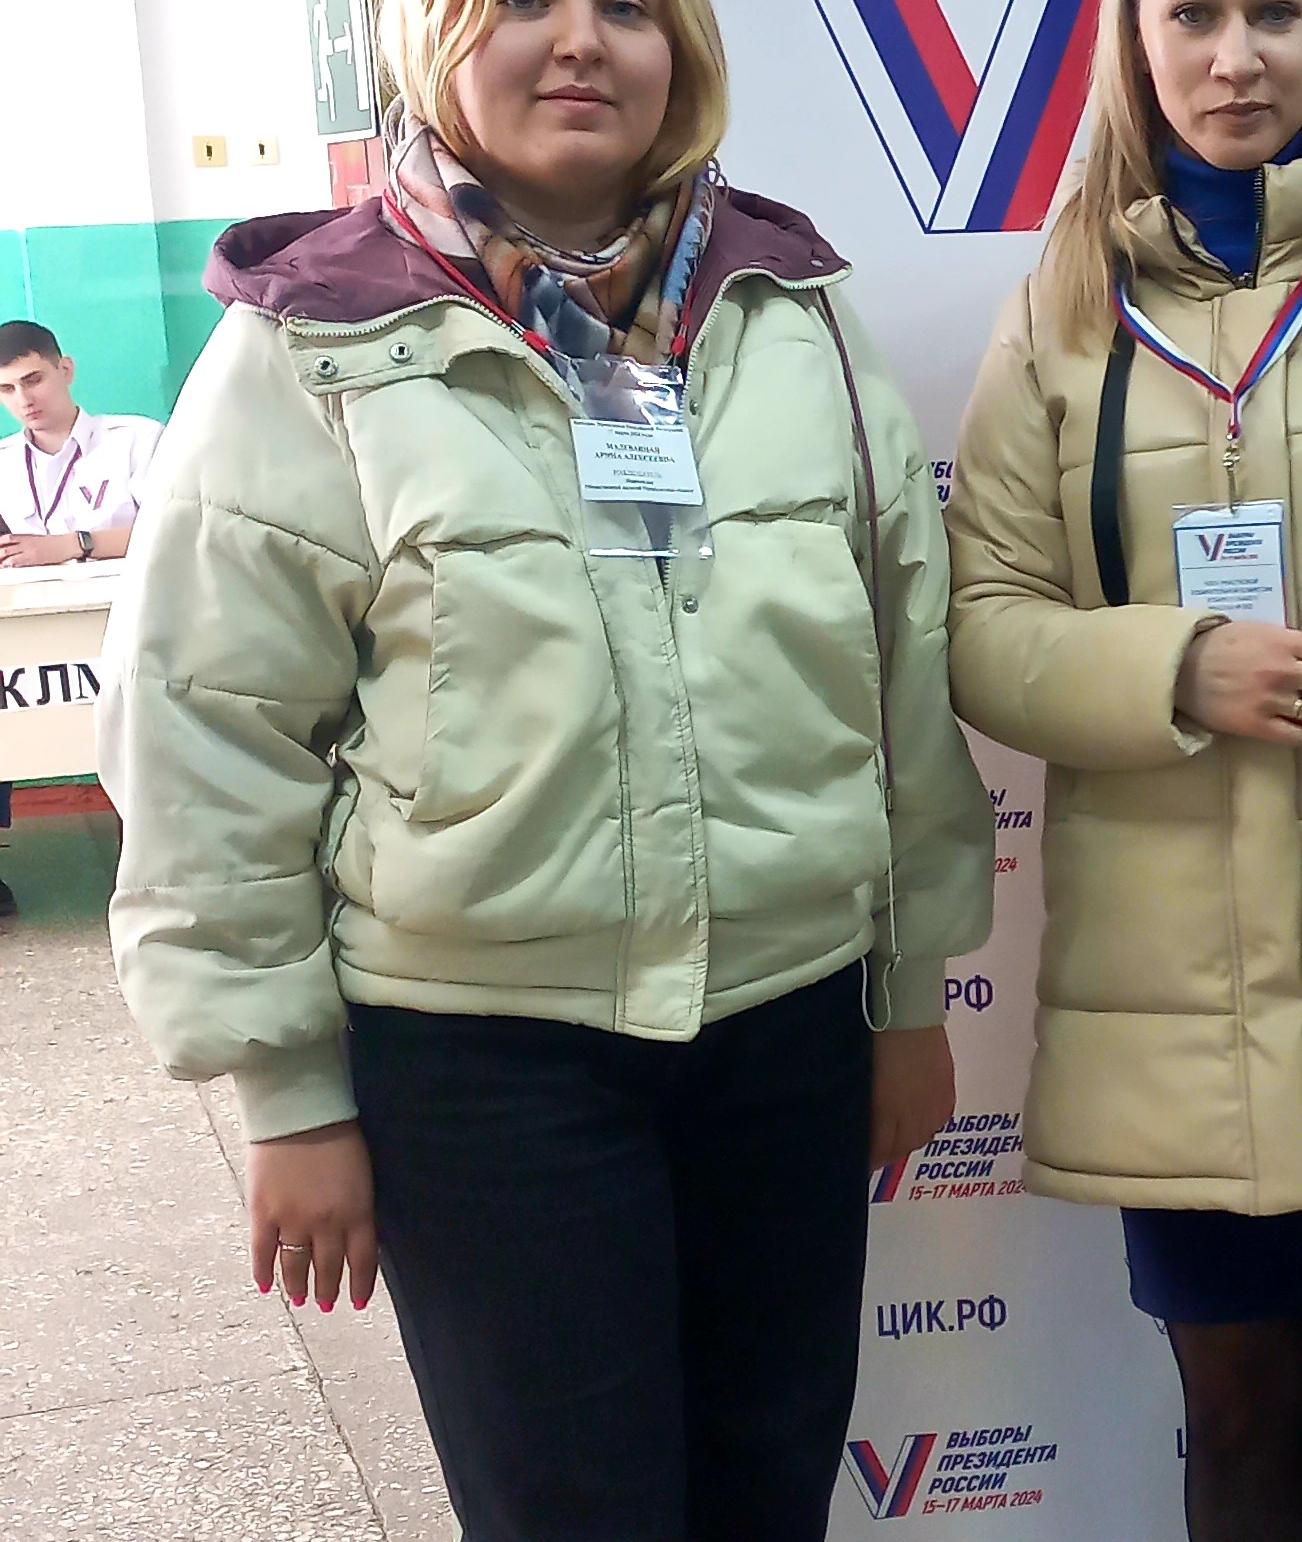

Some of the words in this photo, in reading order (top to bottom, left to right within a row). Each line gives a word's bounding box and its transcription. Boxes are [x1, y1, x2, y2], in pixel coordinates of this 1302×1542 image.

[915, 1159, 995, 1180] РОССИИ
[949, 1182, 996, 1198] МАРТА
[877, 1294, 1007, 1340] ЦИК.РФ
[946, 1424, 1033, 1449] ВЫБОРЫ
[937, 1443, 1057, 1471] ПРЕЗИДЕНТА
[928, 1472, 1007, 1495] РОССИИ
[961, 1493, 1007, 1512] МАРТА
[1009, 1490, 1043, 1508] 2024
